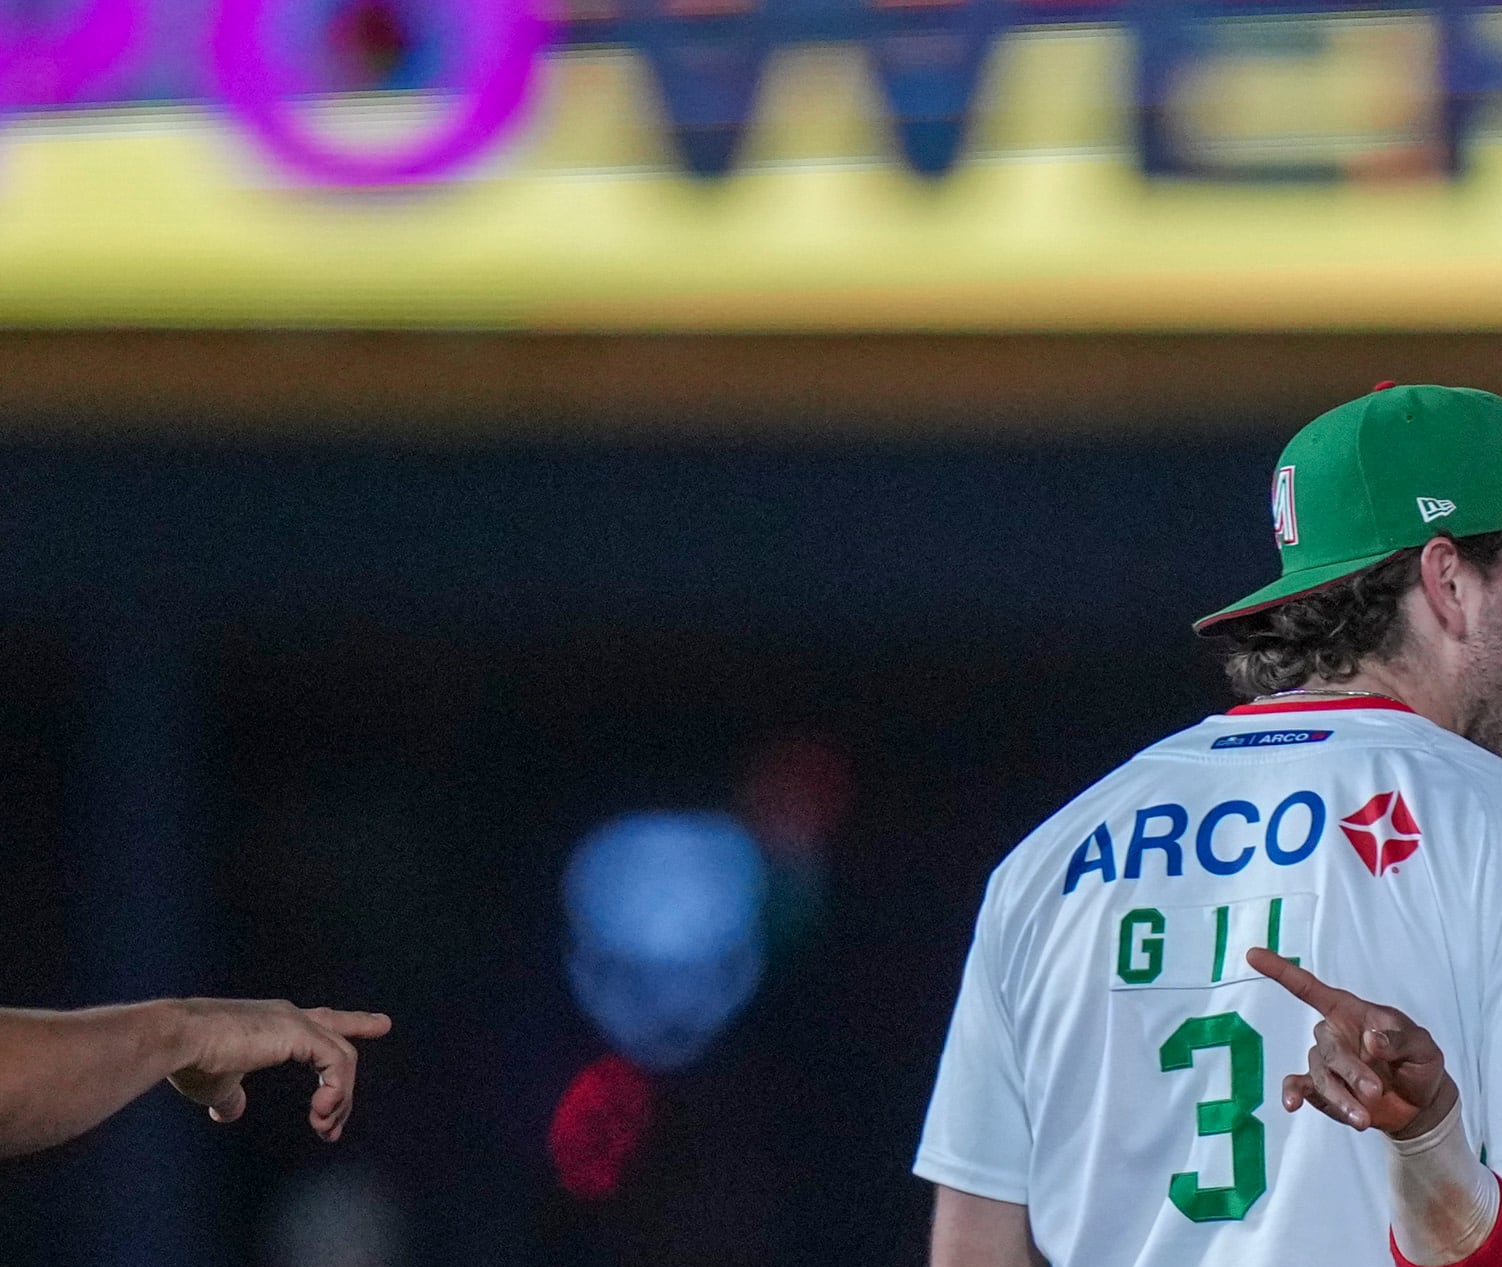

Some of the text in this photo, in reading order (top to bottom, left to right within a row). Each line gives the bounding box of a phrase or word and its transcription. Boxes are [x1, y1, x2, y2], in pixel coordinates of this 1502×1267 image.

[1258, 733, 1309, 744] ARCO
[1061, 789, 1327, 896] ARCO
[1116, 897, 1301, 984] GIL
[1159, 1010, 1268, 1224] 3
